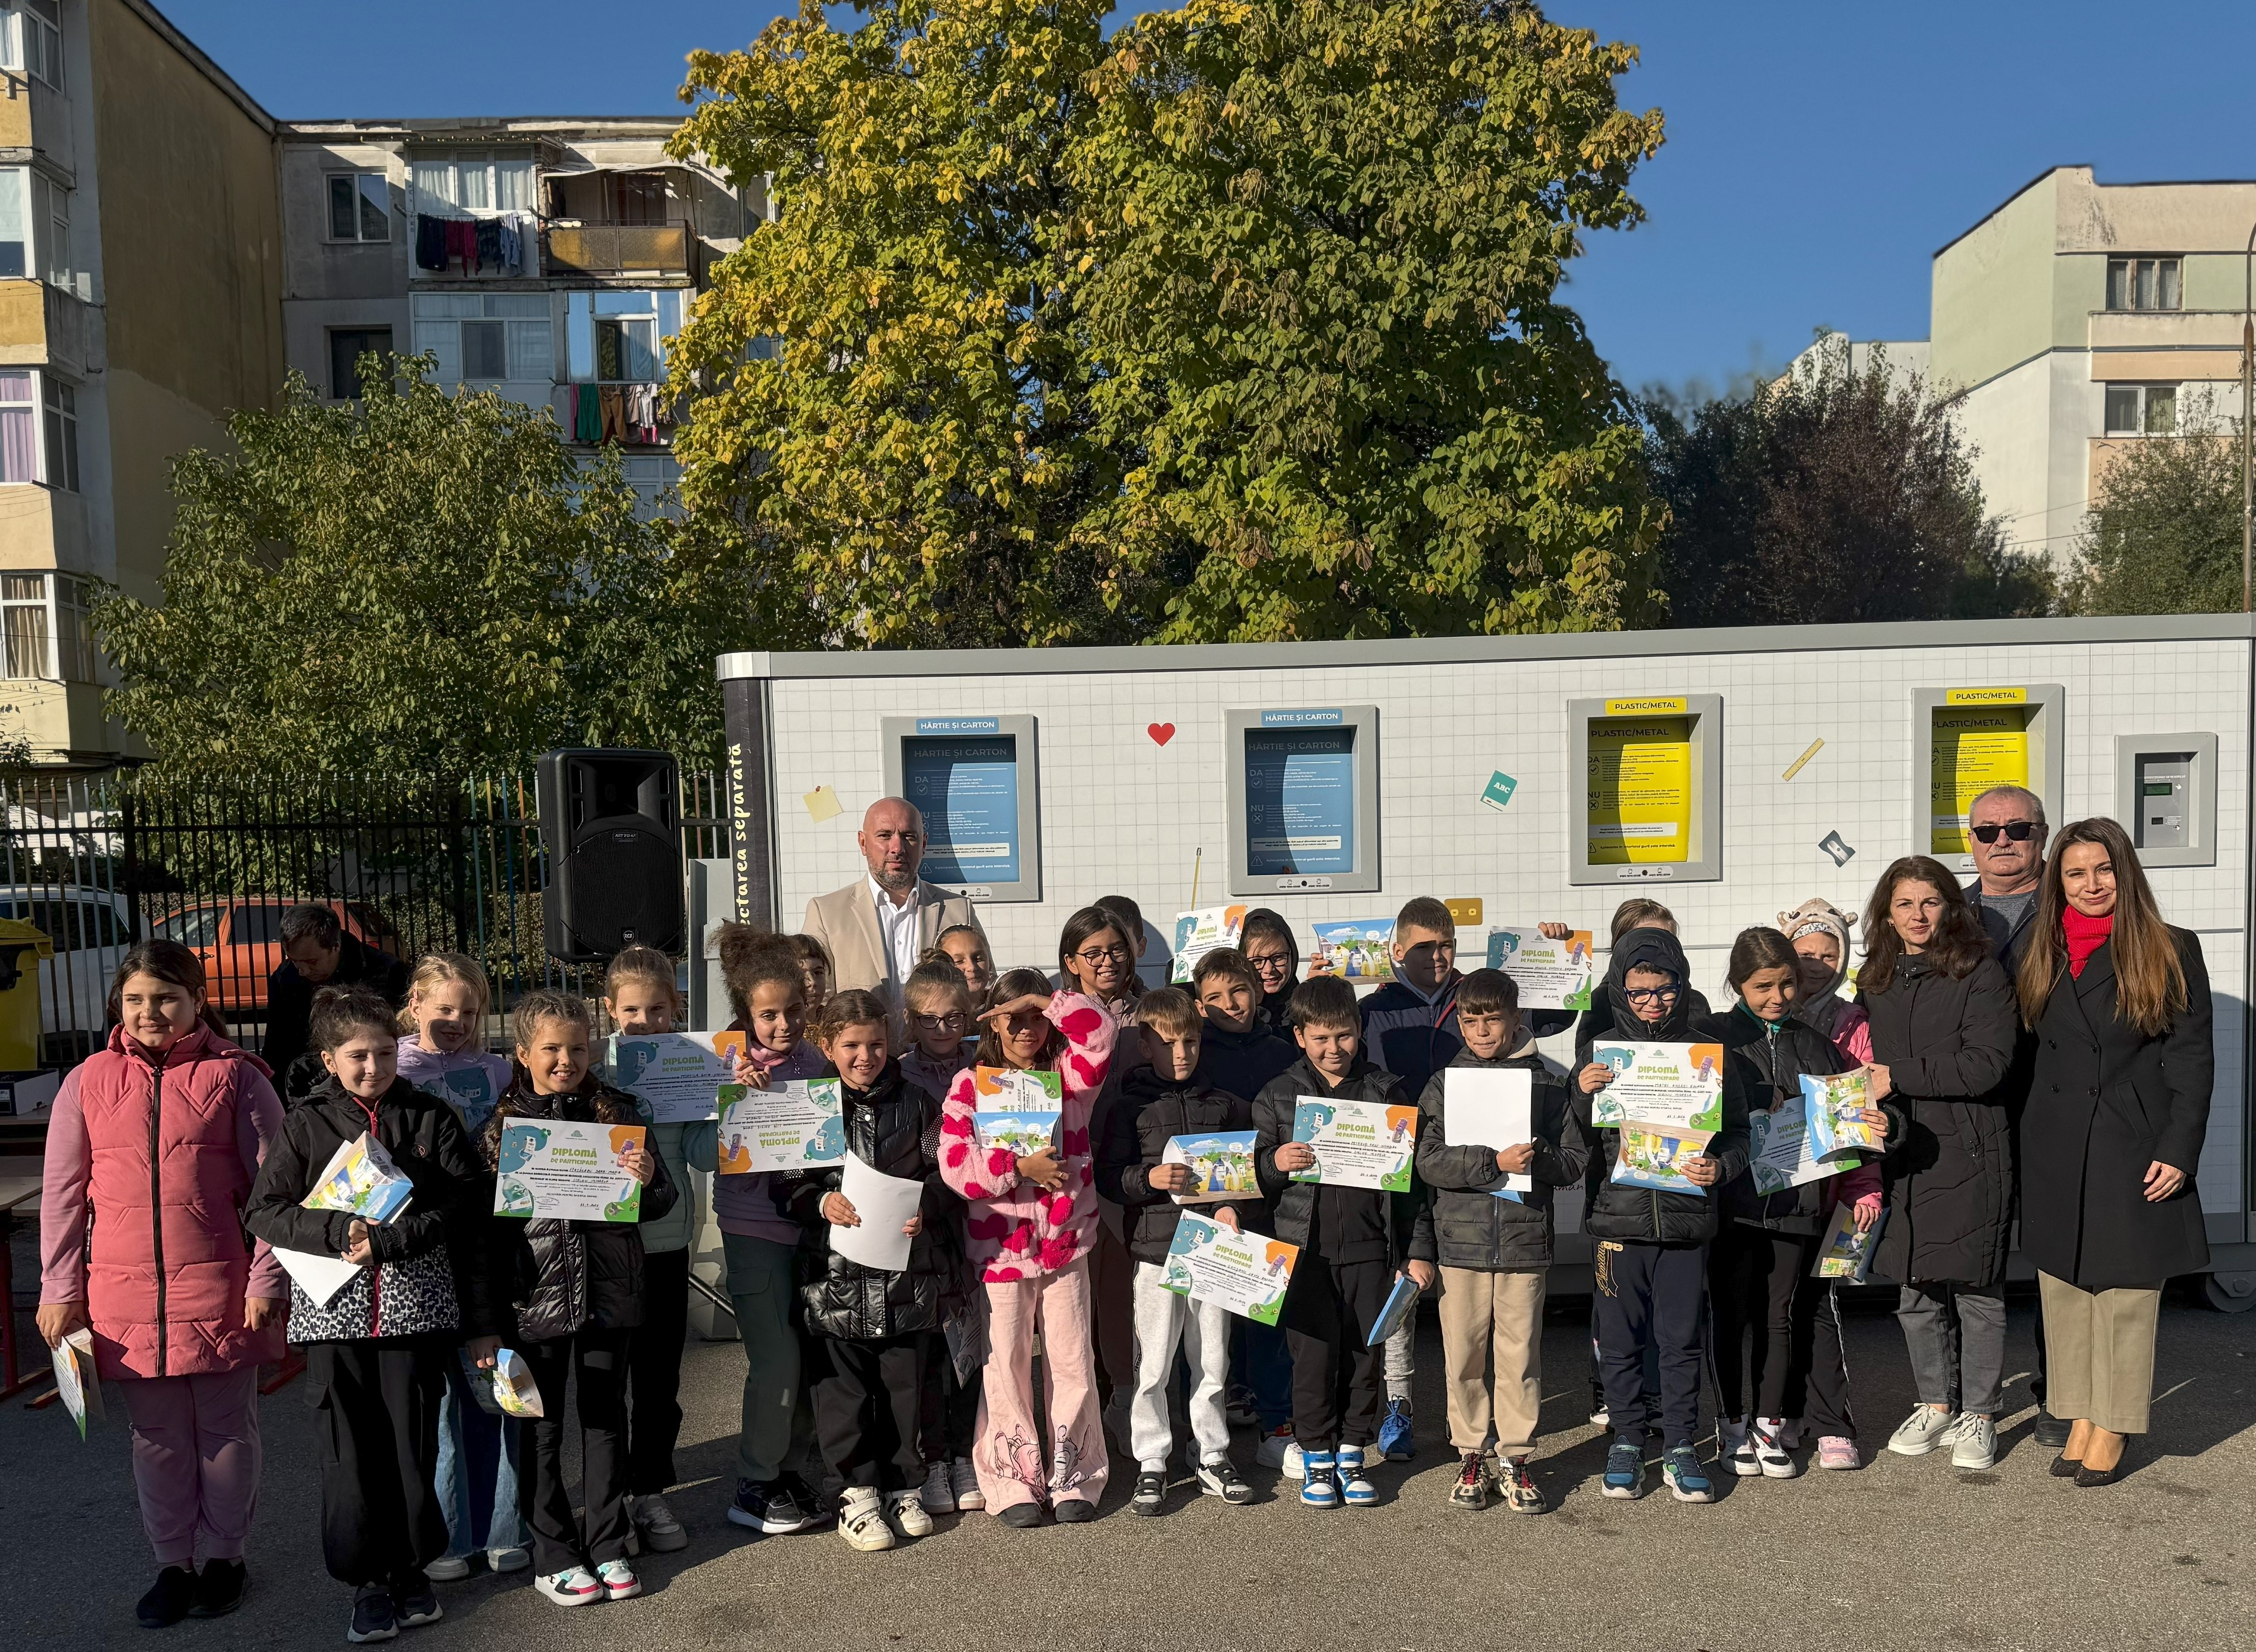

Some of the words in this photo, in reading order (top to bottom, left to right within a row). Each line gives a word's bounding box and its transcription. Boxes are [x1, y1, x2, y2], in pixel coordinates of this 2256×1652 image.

[1956, 692, 2017, 700] PLASTIC/METAL
[1266, 713, 1293, 722] HÂRTIE
[1591, 728, 1669, 737] PLASTIC/METAL
[965, 748, 1007, 756] CARTON
[728, 743, 750, 842] separată
[1493, 782, 1511, 793] ABC
[1521, 949, 1555, 958] DIPLOMĂ
[662, 1055, 704, 1065] DIPLOMĂ
[1638, 1065, 1679, 1074] DIPLOMĂ
[1336, 1123, 1375, 1134] DIPLOMĂ
[1777, 1120, 1807, 1134] DIPLOM
[552, 1147, 597, 1159] DIPLOMĂ
[1215, 1244, 1253, 1263] DIPLOMĂ
